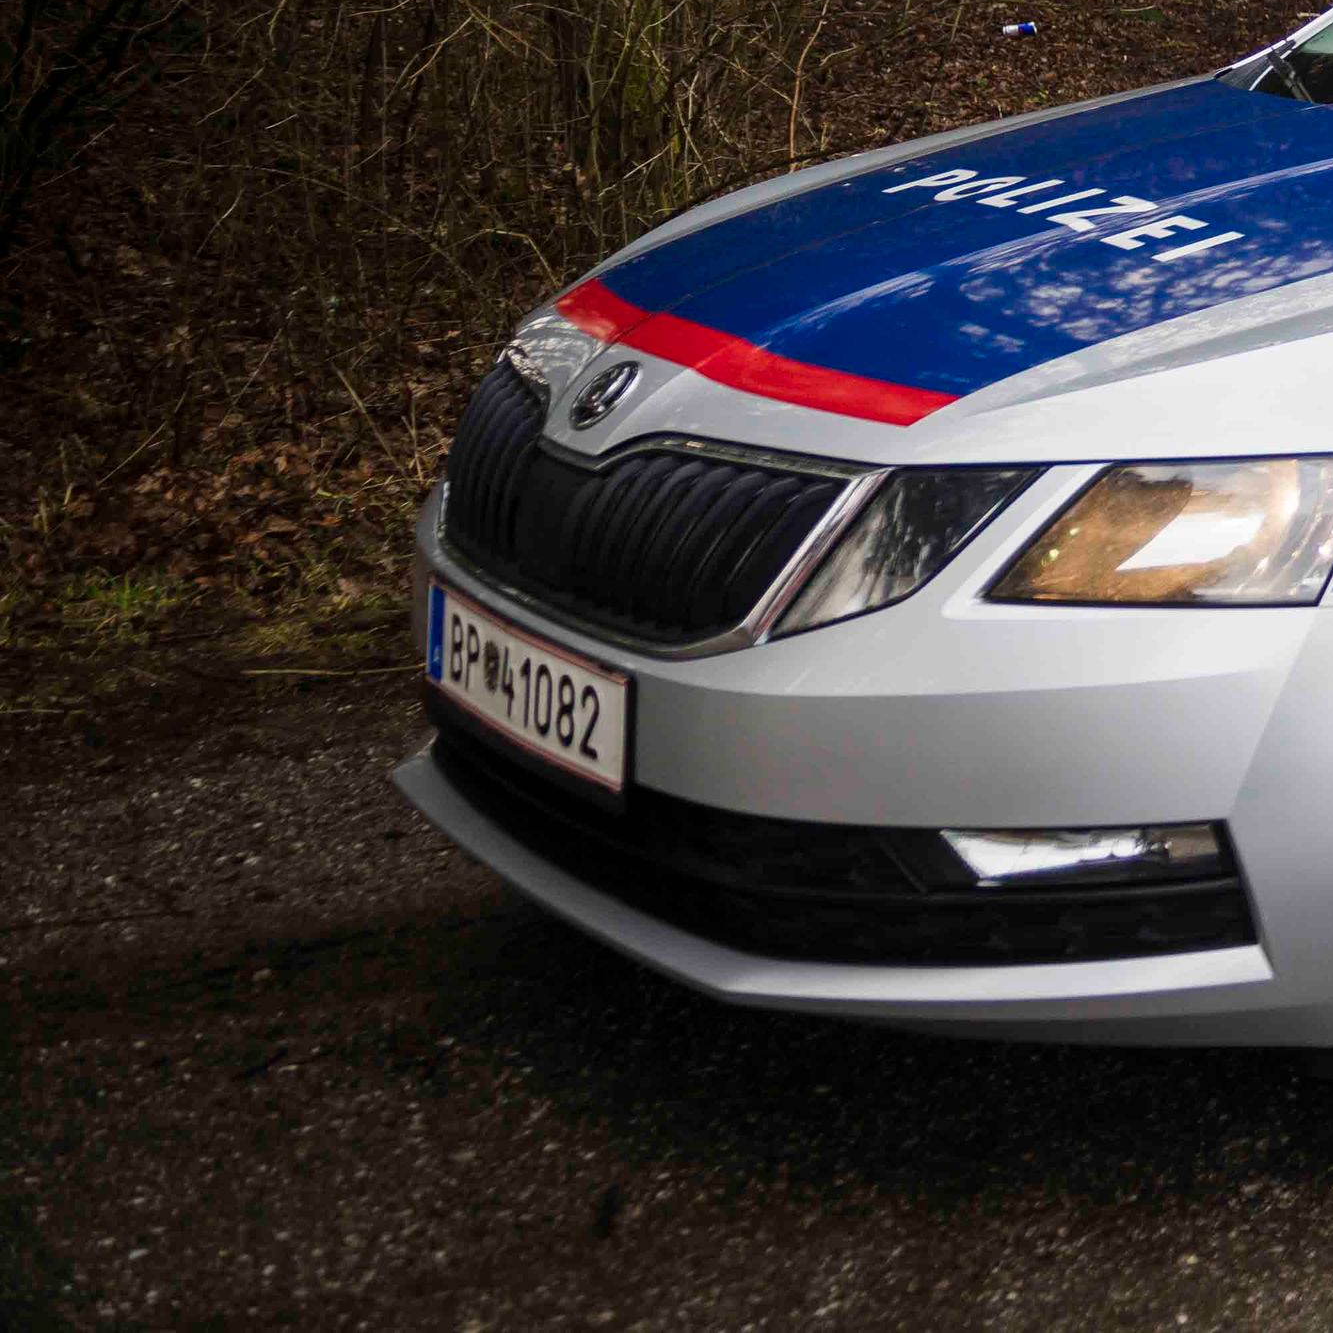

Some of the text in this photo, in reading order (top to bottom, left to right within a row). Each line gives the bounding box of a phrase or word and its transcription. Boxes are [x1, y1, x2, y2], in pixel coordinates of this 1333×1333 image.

[881, 168, 1246, 263] POLIZEI
[450, 613, 601, 762] BP 41082
